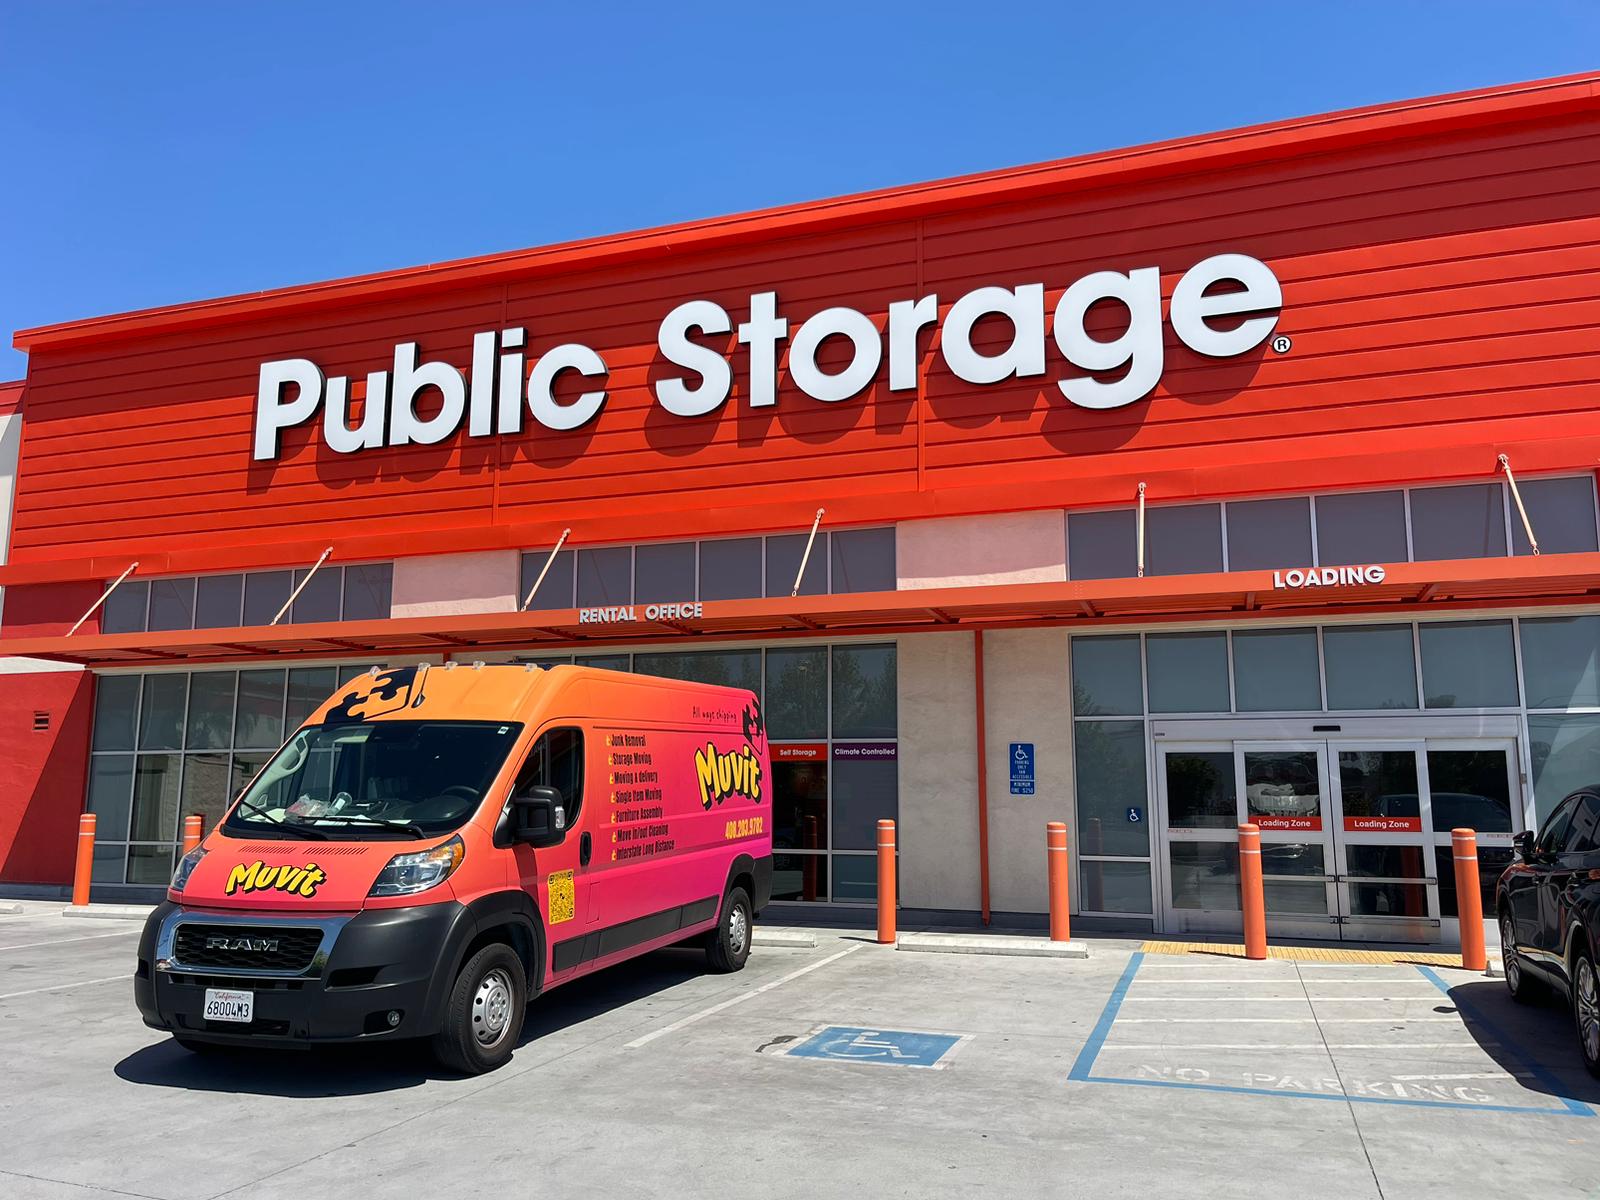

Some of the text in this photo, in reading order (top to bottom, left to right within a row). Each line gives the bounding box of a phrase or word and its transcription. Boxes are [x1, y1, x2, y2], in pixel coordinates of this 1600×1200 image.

[253, 327, 610, 461] Public
[655, 253, 1283, 417] Storage
[1273, 565, 1386, 588] LOADING
[579, 602, 703, 623] RENTAL OFFICE
[692, 705, 700, 719] All
[611, 734, 647, 747] Junk Removal
[613, 752, 652, 766] Storage Moving
[792, 749, 817, 757] Storage
[614, 771, 633, 784] Moving
[639, 770, 658, 783] delivery
[694, 741, 762, 811] Muvit
[616, 788, 662, 804] Single Item Moving
[616, 806, 663, 823] Furniture Assembly
[1258, 819, 1289, 828] Loading
[1354, 820, 1410, 829] Loading Zone
[617, 829, 631, 842] Move
[649, 824, 669, 837] Cleaning
[617, 840, 675, 860] Interstate Long Distance
[225, 860, 327, 898] Muvit
[206, 937, 279, 952] RAM
[215, 991, 242, 1001] California
[207, 1001, 249, 1018] 68004M3
[1136, 1063, 1492, 1102] NO PARKING
